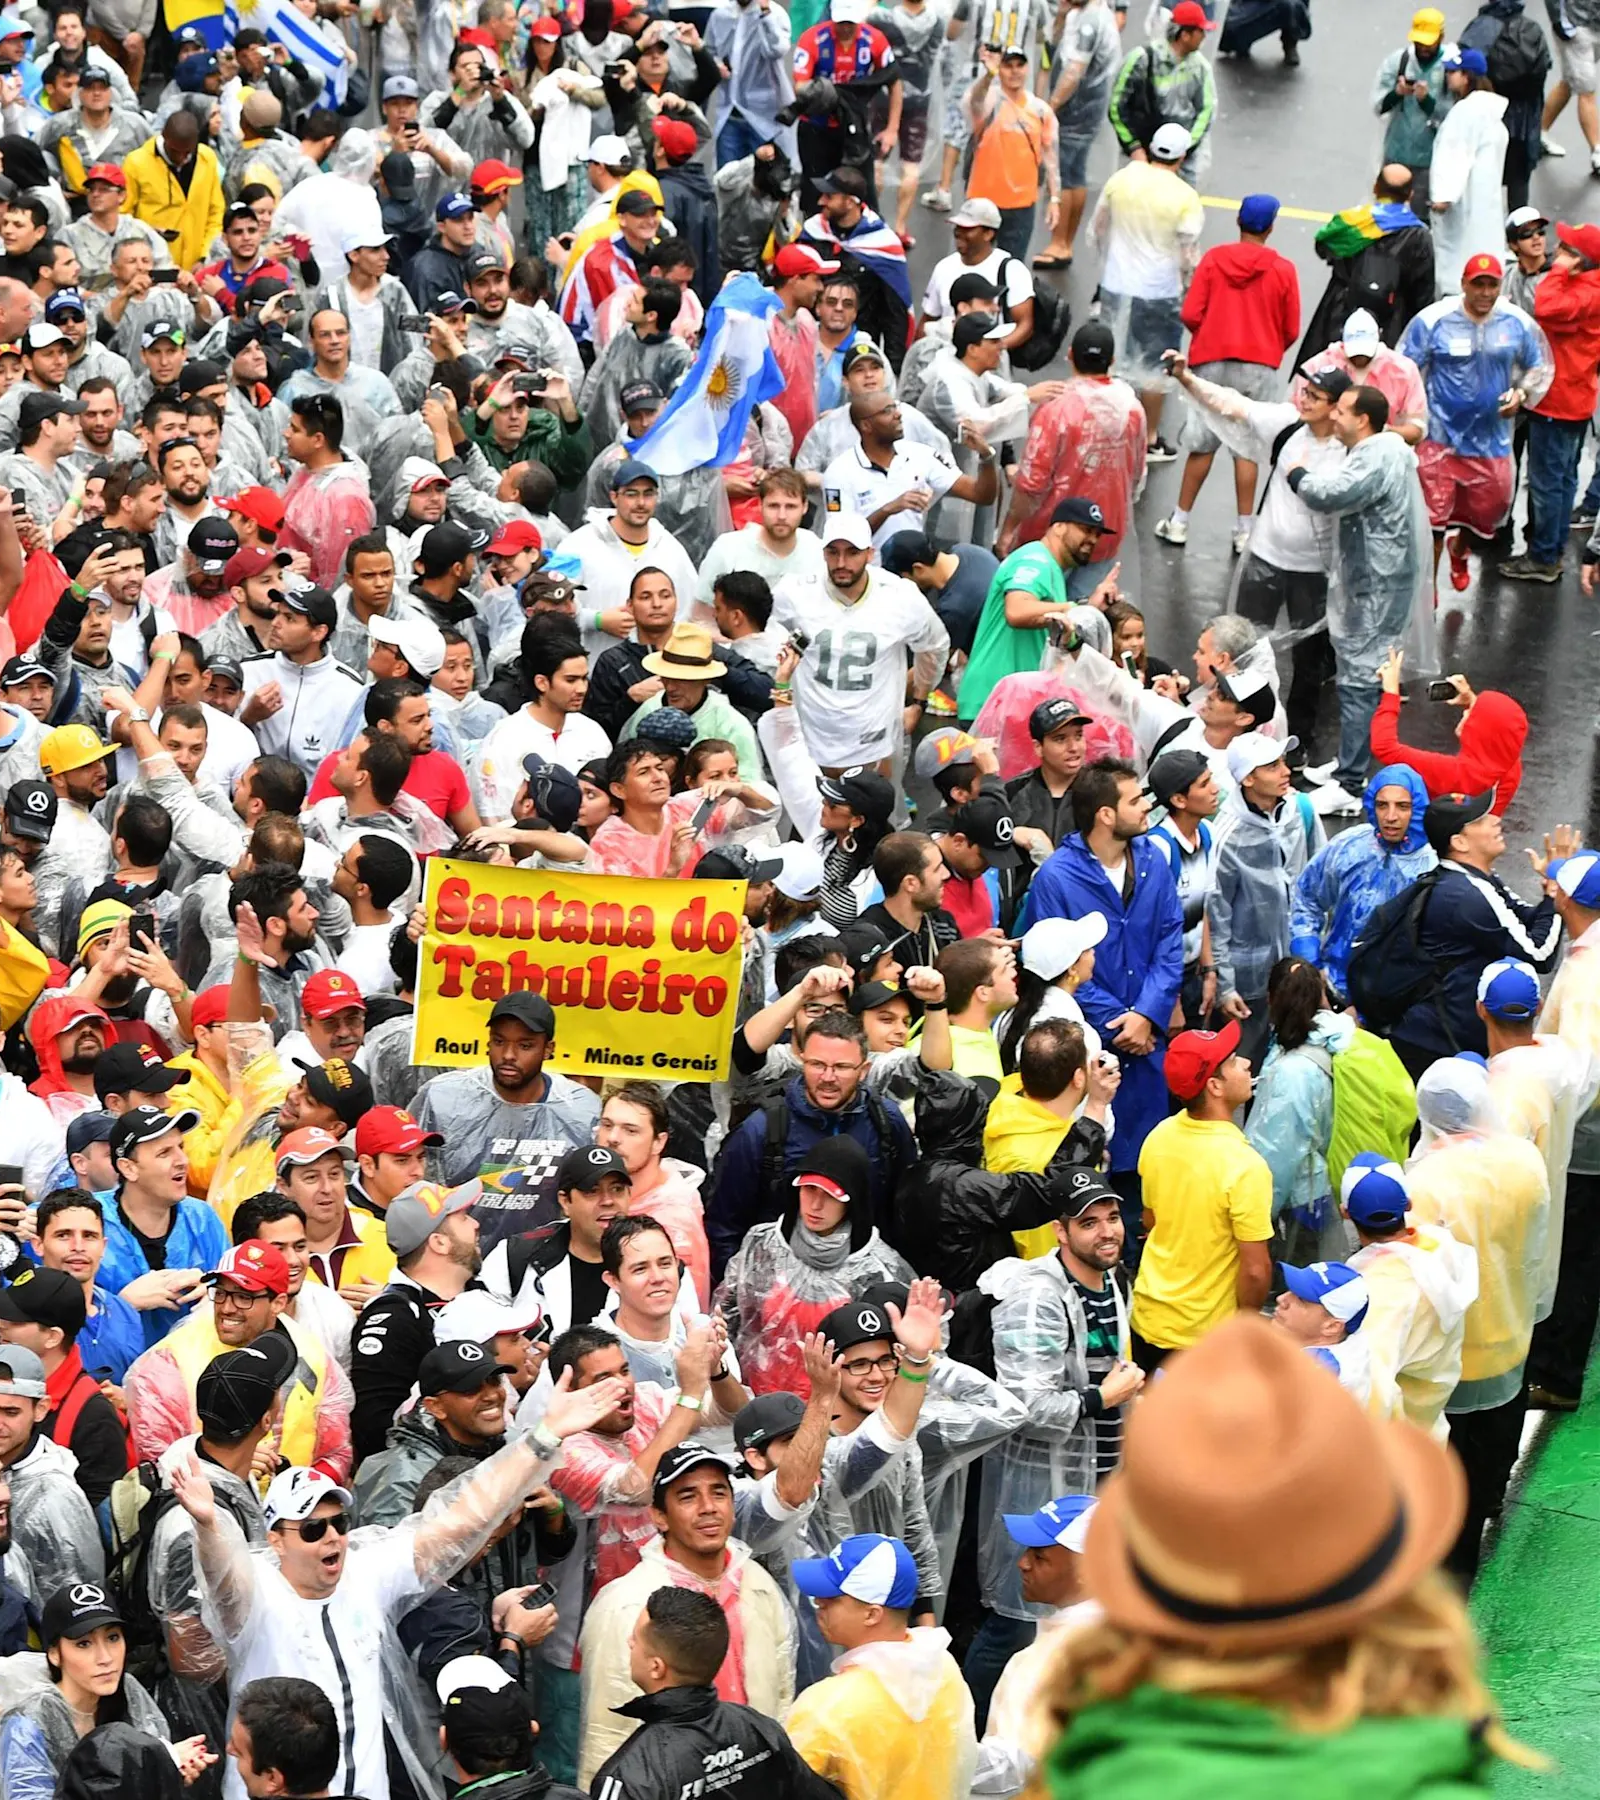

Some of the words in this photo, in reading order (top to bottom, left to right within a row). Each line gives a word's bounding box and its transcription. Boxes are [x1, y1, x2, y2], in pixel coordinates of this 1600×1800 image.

[812, 629, 877, 691] 12
[435, 877, 656, 949] Santana
[671, 896, 738, 955] do
[433, 944, 728, 1017] Tabuleiro
[435, 1037, 479, 1056] Raul
[584, 1047, 644, 1067] Minas
[652, 1052, 718, 1071] Gerais
[702, 1744, 744, 1773] 2016
